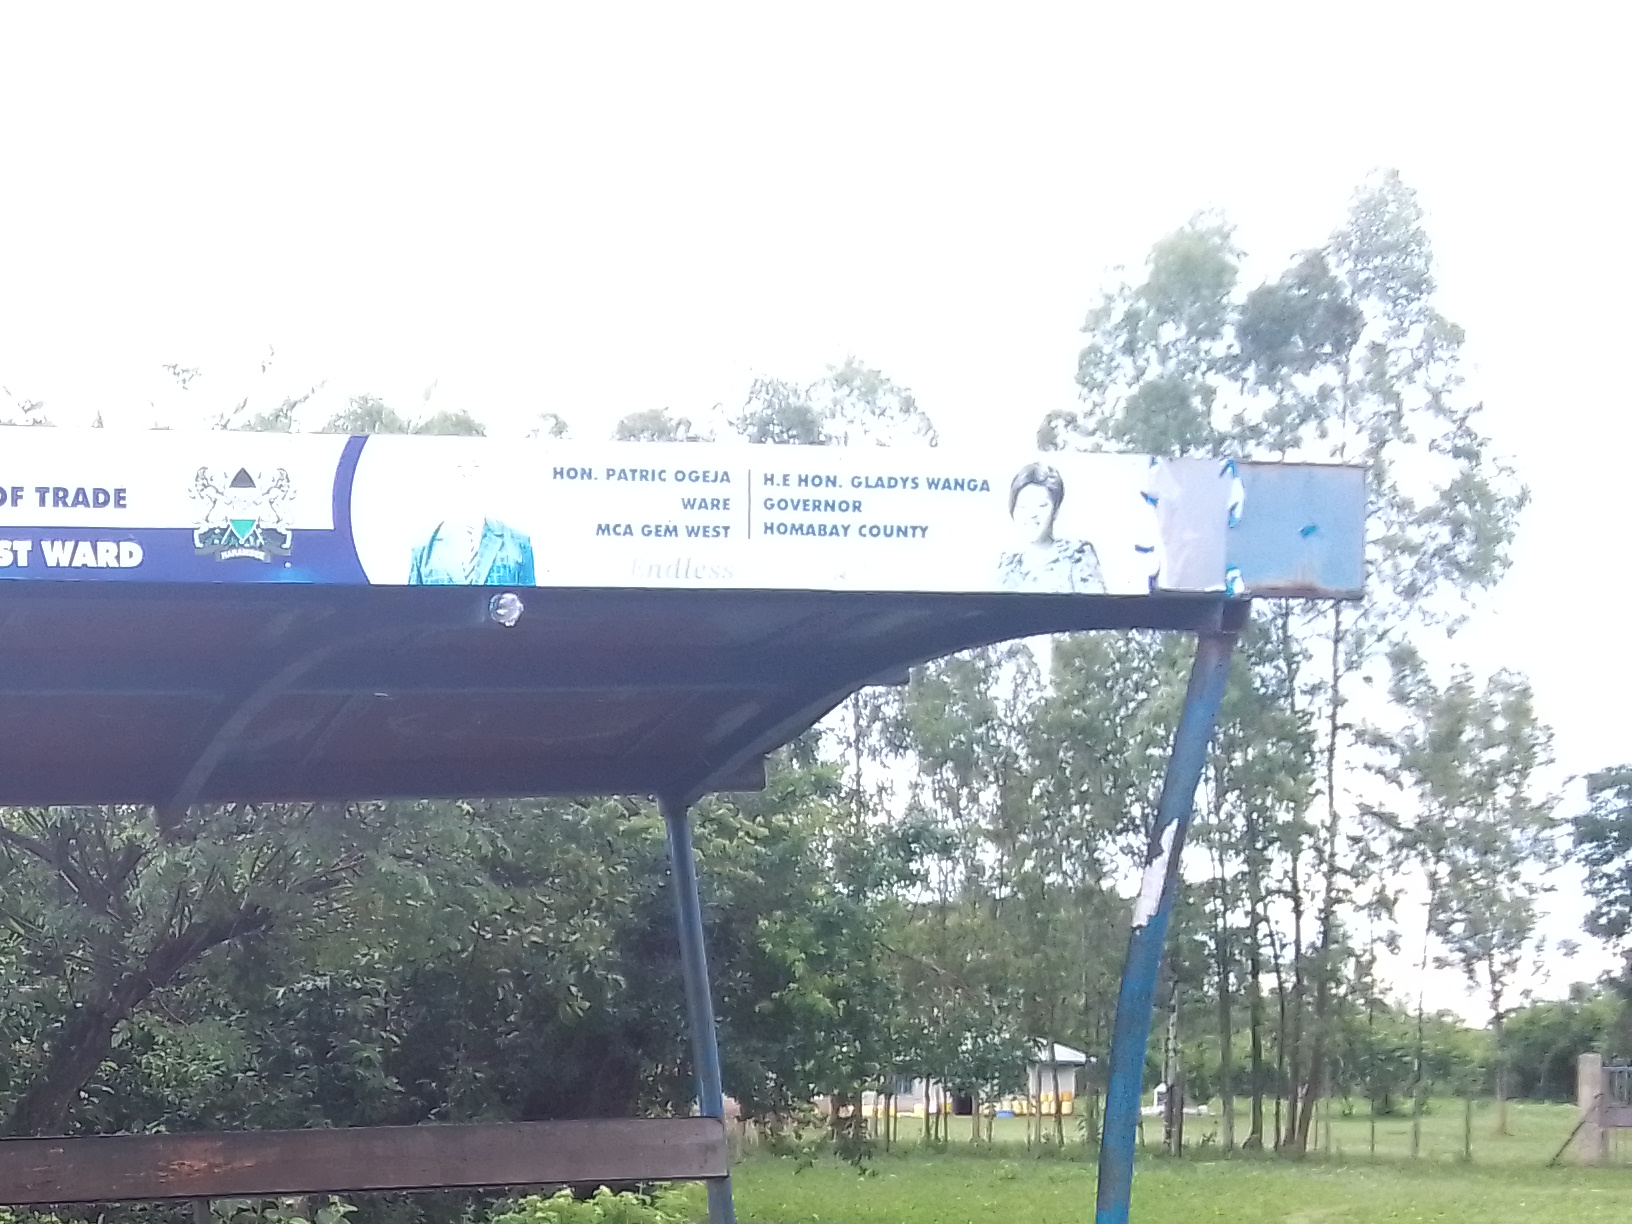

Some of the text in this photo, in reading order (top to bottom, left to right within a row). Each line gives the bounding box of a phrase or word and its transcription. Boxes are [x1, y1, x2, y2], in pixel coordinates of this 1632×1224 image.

[552, 466, 732, 483] HON. PATRIC OGEJA
[762, 473, 991, 492] H.E HON. GLADYS WANGA
[34, 486, 127, 509] TRADE
[681, 497, 731, 511] WARE
[762, 497, 862, 513] GOVERNOR
[595, 523, 732, 538] MCA GEM WEST
[762, 521, 930, 539] HOMABAY COUNTY
[40, 540, 144, 568] WARD
